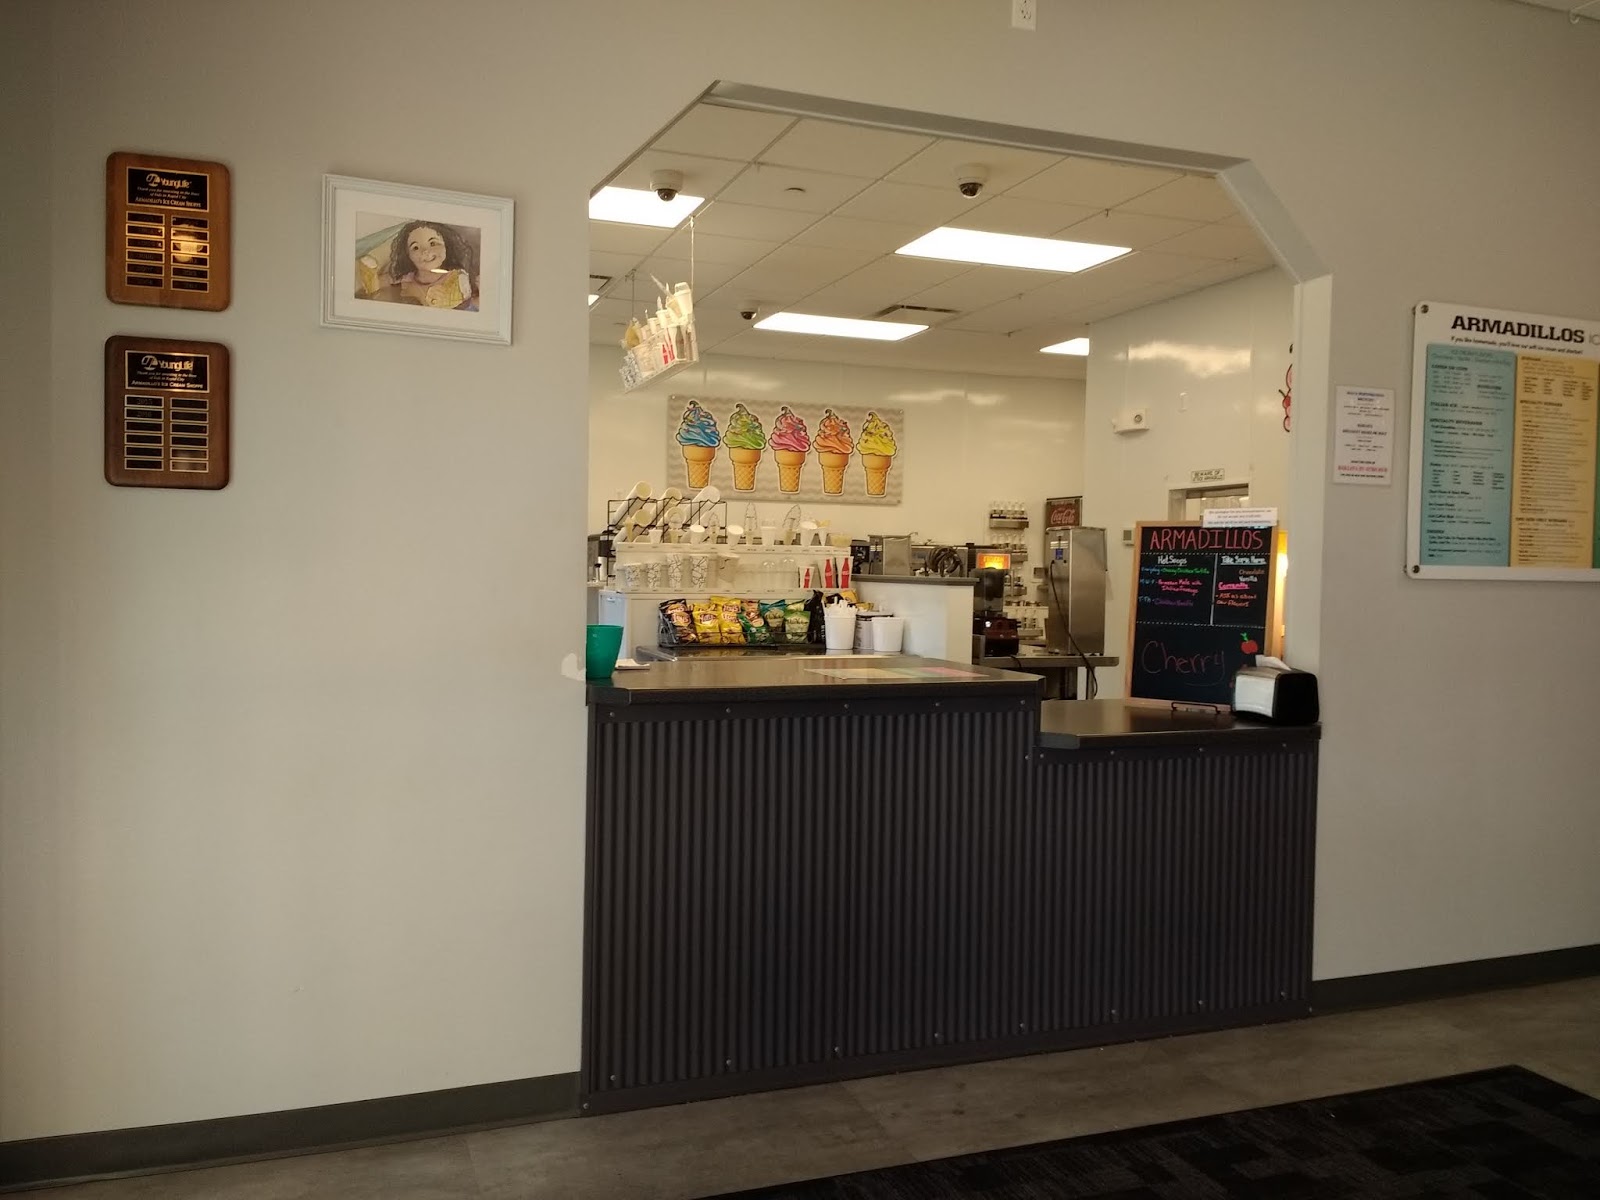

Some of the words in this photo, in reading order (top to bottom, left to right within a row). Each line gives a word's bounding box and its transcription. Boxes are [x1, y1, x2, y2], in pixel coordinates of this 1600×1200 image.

[1451, 315, 1585, 344] ARMADILLOS
[1150, 529, 1263, 550] ARMADILLOS
[1157, 554, 1168, 565] Hot
[1168, 554, 1188, 567] Soups
[1141, 640, 1226, 687] Cherry
